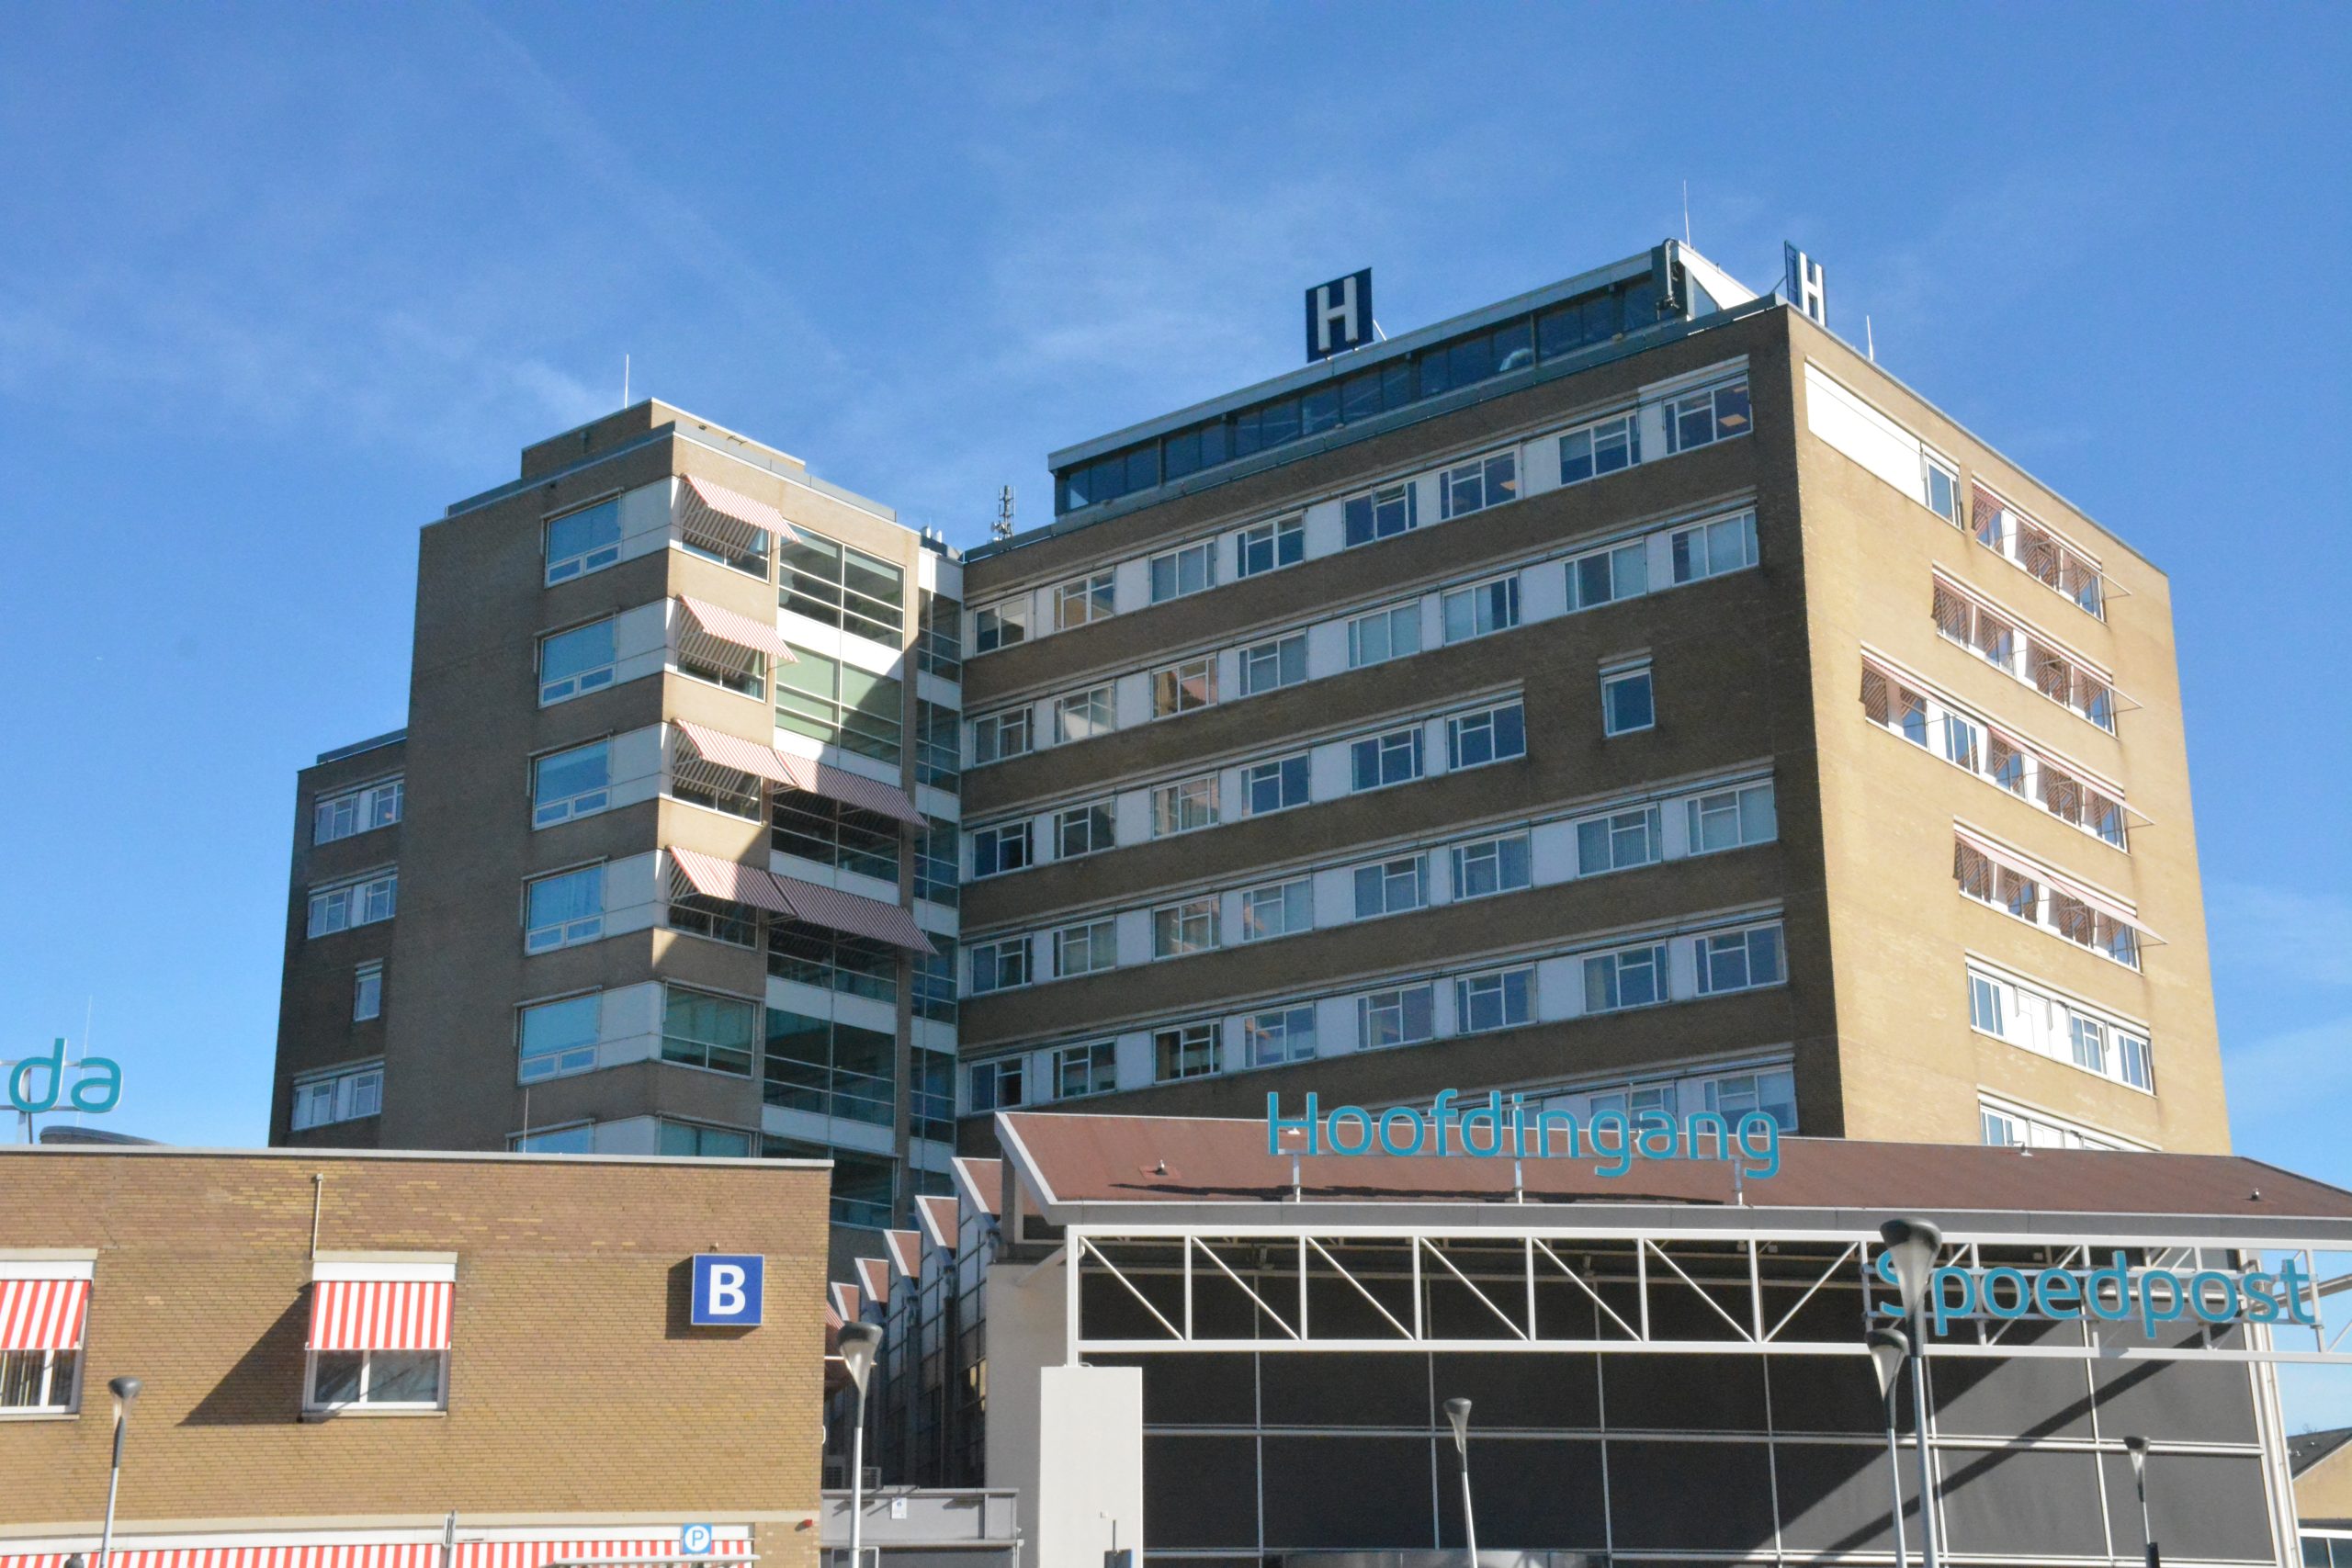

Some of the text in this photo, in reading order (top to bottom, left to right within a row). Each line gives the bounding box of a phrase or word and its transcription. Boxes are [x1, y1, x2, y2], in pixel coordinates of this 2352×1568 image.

[1316, 276, 1358, 352] H
[1799, 251, 1826, 327] H
[1267, 1088, 1781, 1179] Hoofdingang
[708, 1264, 746, 1315] B
[692, 1529, 705, 1547] P
